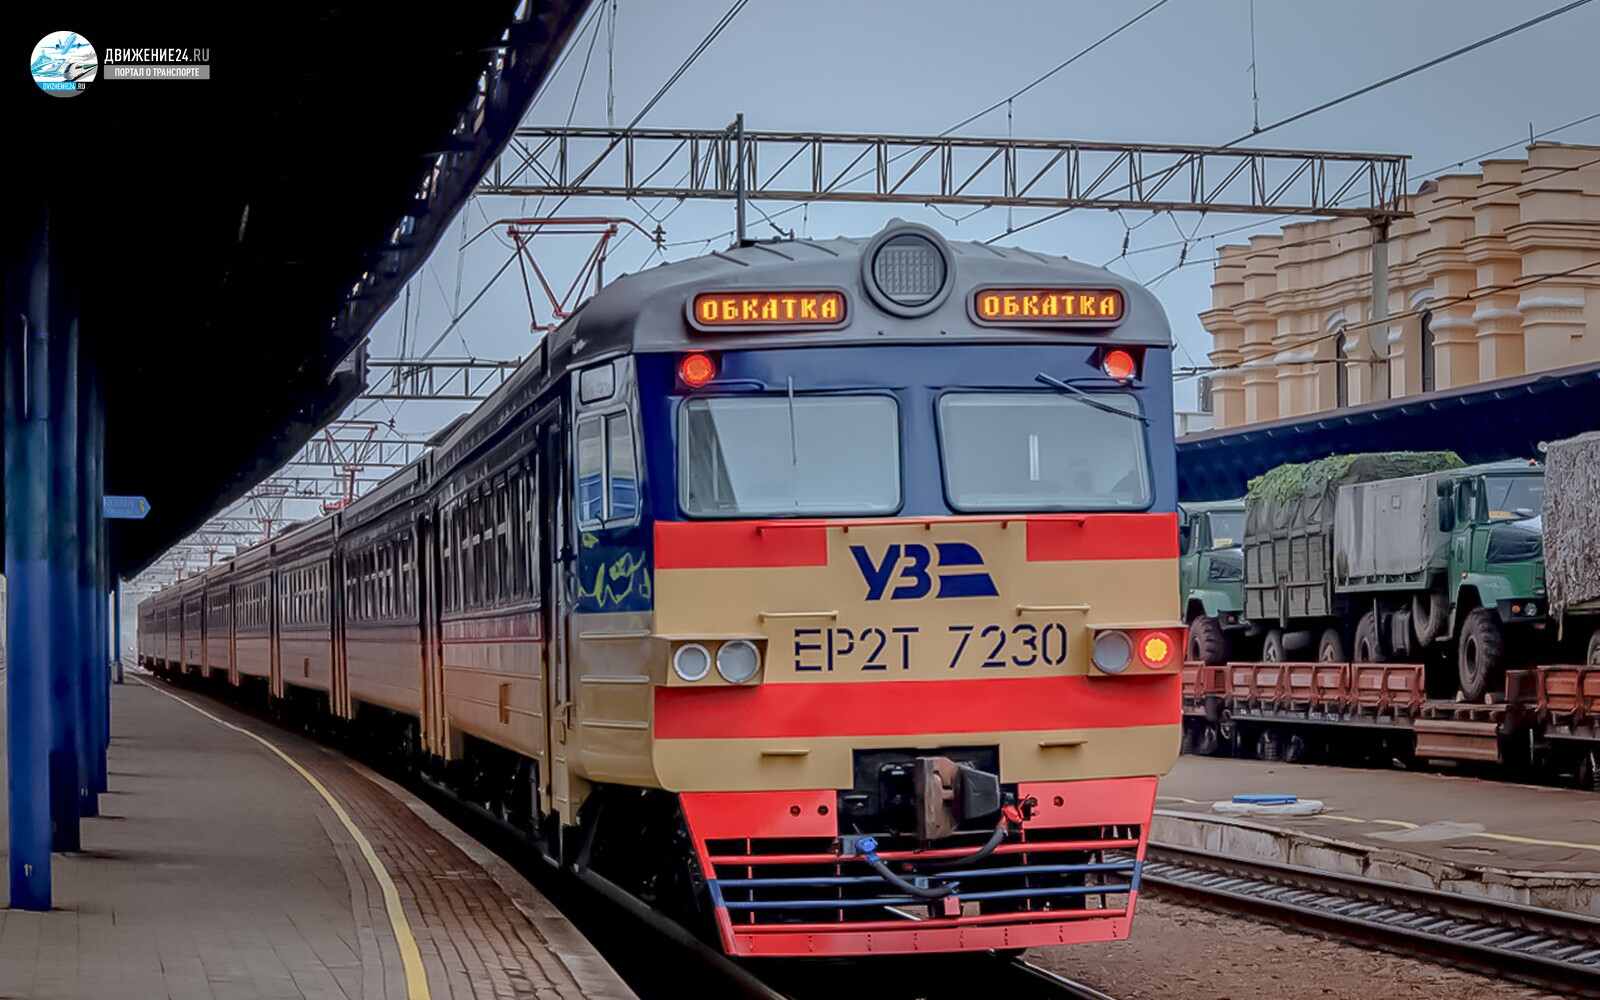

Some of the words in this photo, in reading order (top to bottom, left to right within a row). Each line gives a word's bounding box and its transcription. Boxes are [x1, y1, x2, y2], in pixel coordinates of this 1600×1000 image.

[702, 298, 838, 320] ОБКАТКА
[984, 294, 1118, 317] ОБКАТКА
[948, 623, 1067, 668] 7230
